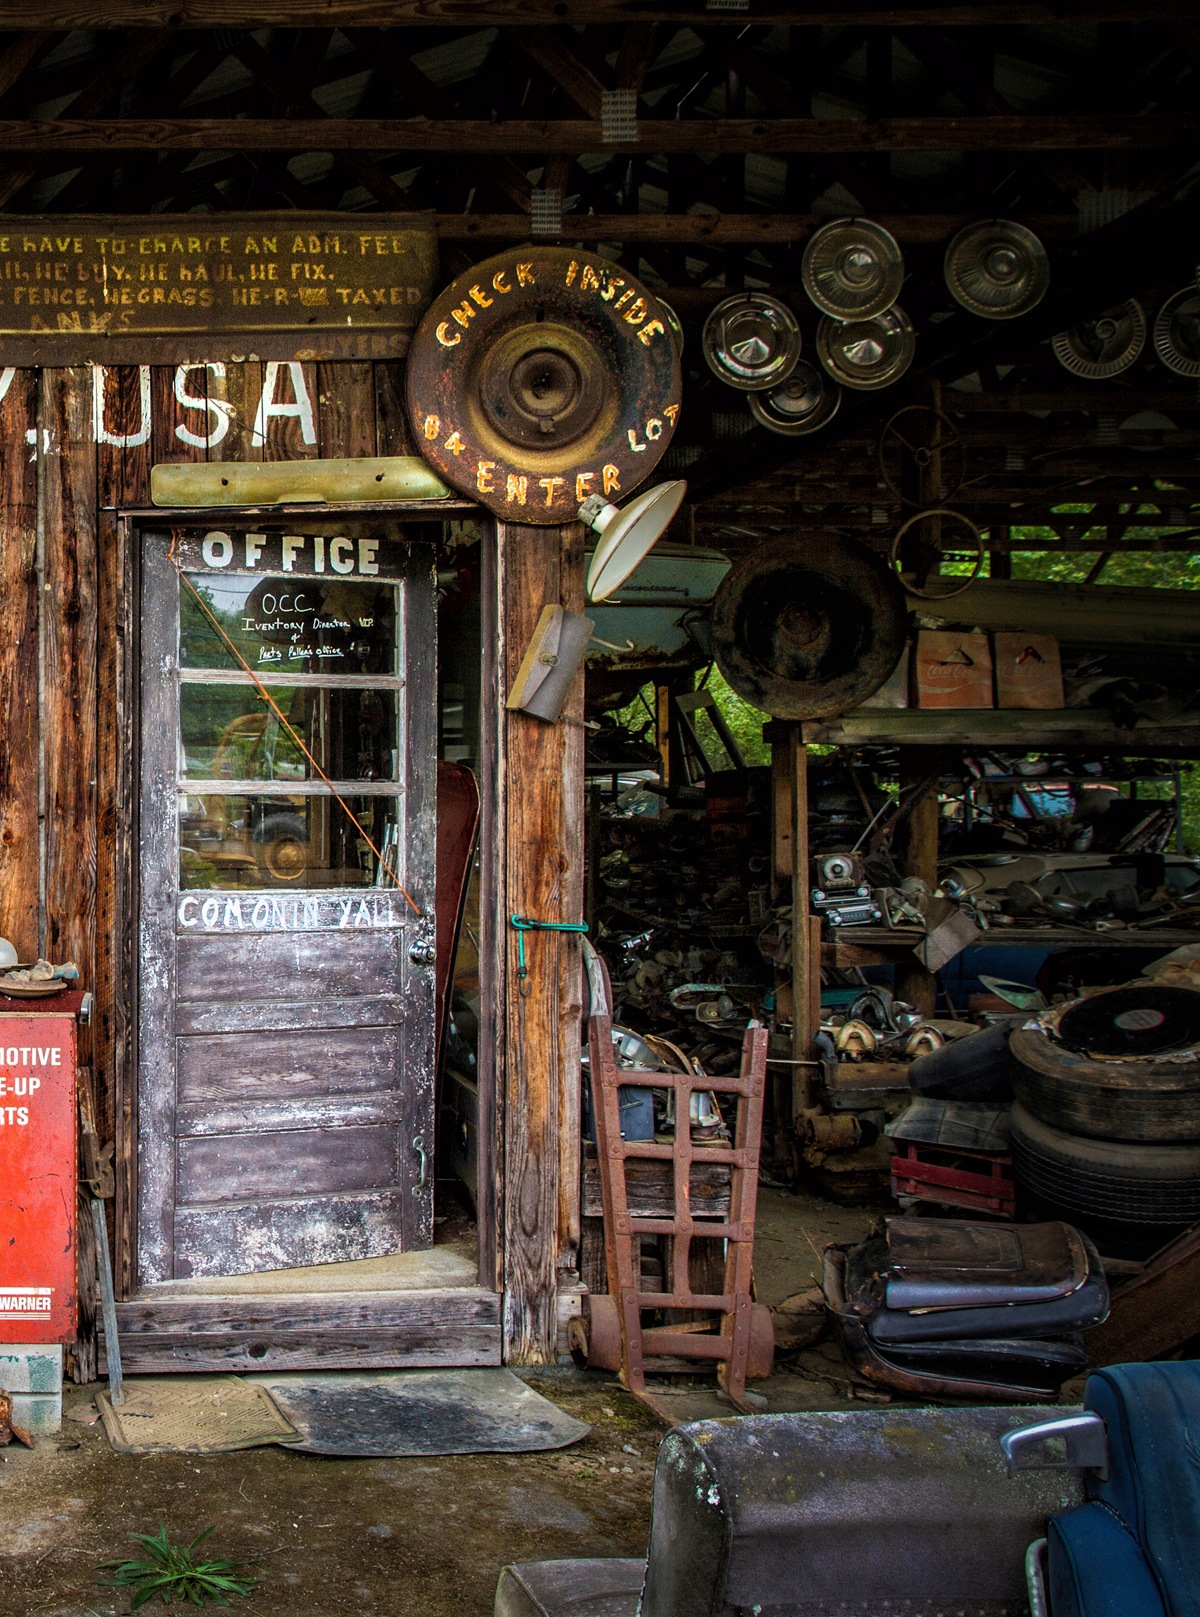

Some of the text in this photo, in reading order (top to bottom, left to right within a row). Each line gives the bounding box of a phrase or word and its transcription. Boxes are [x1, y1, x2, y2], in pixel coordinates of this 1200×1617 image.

[245, 236, 277, 254] AN
[139, 263, 168, 281] WE
[250, 263, 278, 280] WE
[291, 263, 335, 281] FIX.
[435, 260, 665, 347] CHECK INSIDE
[476, 460, 621, 507] ENTER
[627, 404, 680, 452] LOT
[202, 531, 379, 575] OFFICE
